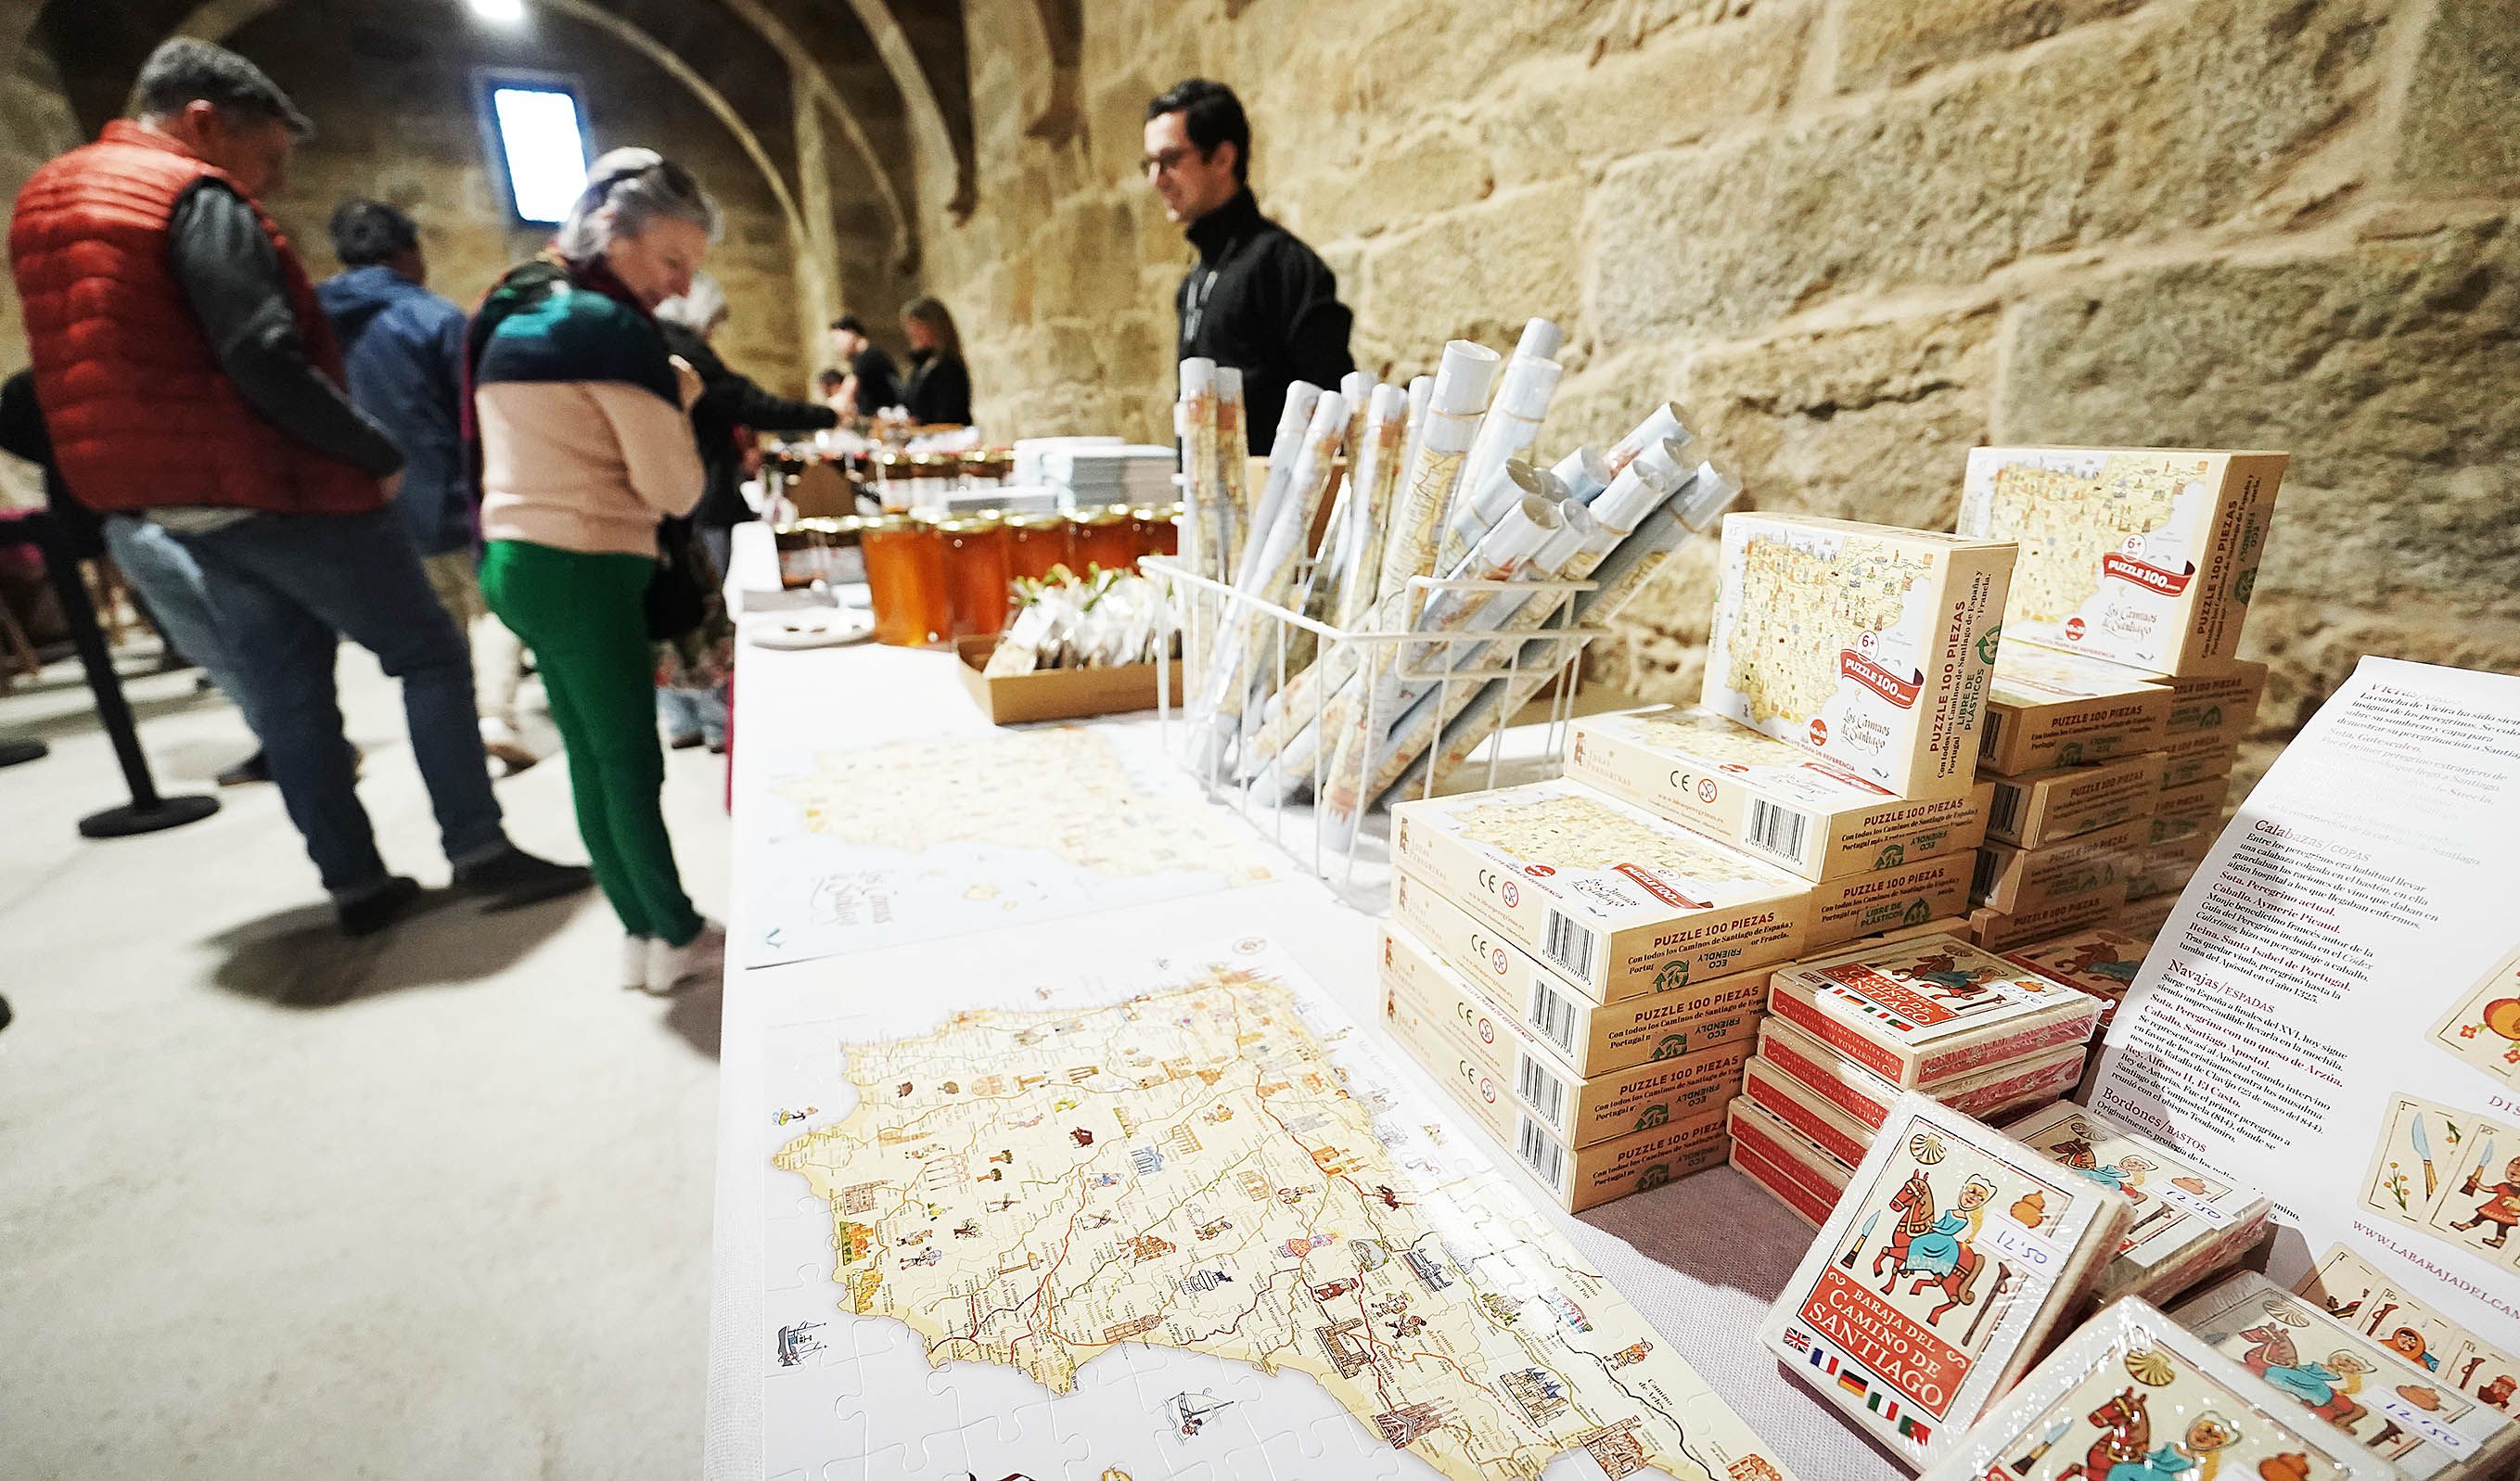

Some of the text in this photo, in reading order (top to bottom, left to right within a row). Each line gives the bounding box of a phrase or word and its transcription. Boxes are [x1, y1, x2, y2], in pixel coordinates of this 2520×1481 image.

[2108, 560, 2168, 587] PUZZLE 100
[2196, 500, 2237, 634] PUZZLE 100 PIEZAS
[1967, 577, 1981, 612] España
[1965, 613, 1973, 625] de
[1862, 635, 1875, 647] 6+
[1957, 626, 1972, 667] Santiago
[1845, 658, 1898, 696] PUZZLE 100
[1929, 600, 1966, 753] PUZZLE 100 PIEZAS
[1947, 573, 1991, 775] Portugal Francia.
[1955, 669, 1963, 680] de
[1947, 681, 1961, 720] Caminos
[1957, 673, 1975, 725] LIBRE DE
[1963, 667, 1985, 731] PLÁSTICOS
[2051, 704, 2143, 728] PUZZLE 100 PIEZAS
[1940, 735, 1951, 760] todos
[1944, 722, 1953, 735] los
[1937, 760, 1946, 779] Con
[1863, 797, 1964, 827] PUZZLE 100 PIEZAS
[1842, 867, 1944, 899] PUZZLE 100 PIEZAS
[2219, 870, 2335, 916] Sota. Peregrino actual.
[1866, 901, 1902, 918] LIBRE DE
[2212, 882, 2340, 933] Caballo. Aymeric Picaud.
[1627, 954, 1643, 965] Con
[1643, 949, 1666, 961] todos
[1666, 946, 1678, 955] los
[1678, 939, 1711, 952] Caminos
[1711, 936, 1721, 945] de
[1721, 929, 1753, 944] Santiago
[1753, 926, 1763, 935] de
[1763, 921, 1788, 933] España
[1653, 911, 1775, 948] PUZZLE 100 PIEZAS
[1760, 930, 1790, 944] Francia.
[1697, 945, 1742, 964] FRIENDLY
[1708, 959, 1727, 970] ECO
[2178, 941, 2205, 957] tumba
[2204, 952, 2220, 962] del
[2218, 958, 2253, 976] Apóstol
[2252, 973, 2264, 981] en
[2274, 981, 2292, 992] año
[2293, 987, 2317, 1003] 1325.
[2188, 921, 2350, 991] Reina. Santa Isabel de Portugal.
[1634, 984, 1759, 1024] PUZZLE 100 PIEZAS
[1827, 969, 1933, 1024] SANTIAGO
[1846, 969, 1934, 1014] CAMINO DE
[1869, 974, 1936, 1006] BARAJA DEL
[1695, 1016, 1740, 1034] FRIENDLY
[1707, 1028, 1726, 1039] ECO
[2144, 1004, 2181, 1028] Caballo.
[2183, 1023, 2226, 1048] Santiago
[2149, 993, 2173, 1009] Sota.
[2175, 1004, 2222, 1031] Peregrina
[2222, 1028, 2241, 1040] con
[2242, 1036, 2256, 1046] un
[2257, 1044, 2289, 1061] queso
[2290, 1058, 2304, 1067] de
[2155, 983, 2342, 1071] siendo imprescindible llevarla en la mochila.
[1619, 1054, 1738, 1095] PUZZLE 100 PIEZAS
[1676, 1083, 1720, 1102] FRIENDLY
[2124, 1043, 2240, 1108] Rey. Alfonso II. El Casto.
[1688, 1095, 1706, 1106] ECO
[2115, 1061, 2150, 1084] Santiago
[2149, 1079, 2161, 1089] de
[2160, 1085, 2210, 1115] Compostela
[2236, 1126, 2264, 1143] donde
[1617, 1119, 1726, 1161] PUZZLE 100 PIEZA
[2096, 1100, 2152, 1137] Originalmente,
[2187, 1152, 2198, 1160] de
[2198, 1157, 2210, 1168] los
[1829, 1289, 1941, 1378] CAMINO DE
[1854, 1289, 1937, 1352] BARAJA DEL
[1376, 1345, 1395, 1369] Camino
[1808, 1302, 1943, 1407] SANTIAGO
[1648, 1378, 1673, 1406] Camino
